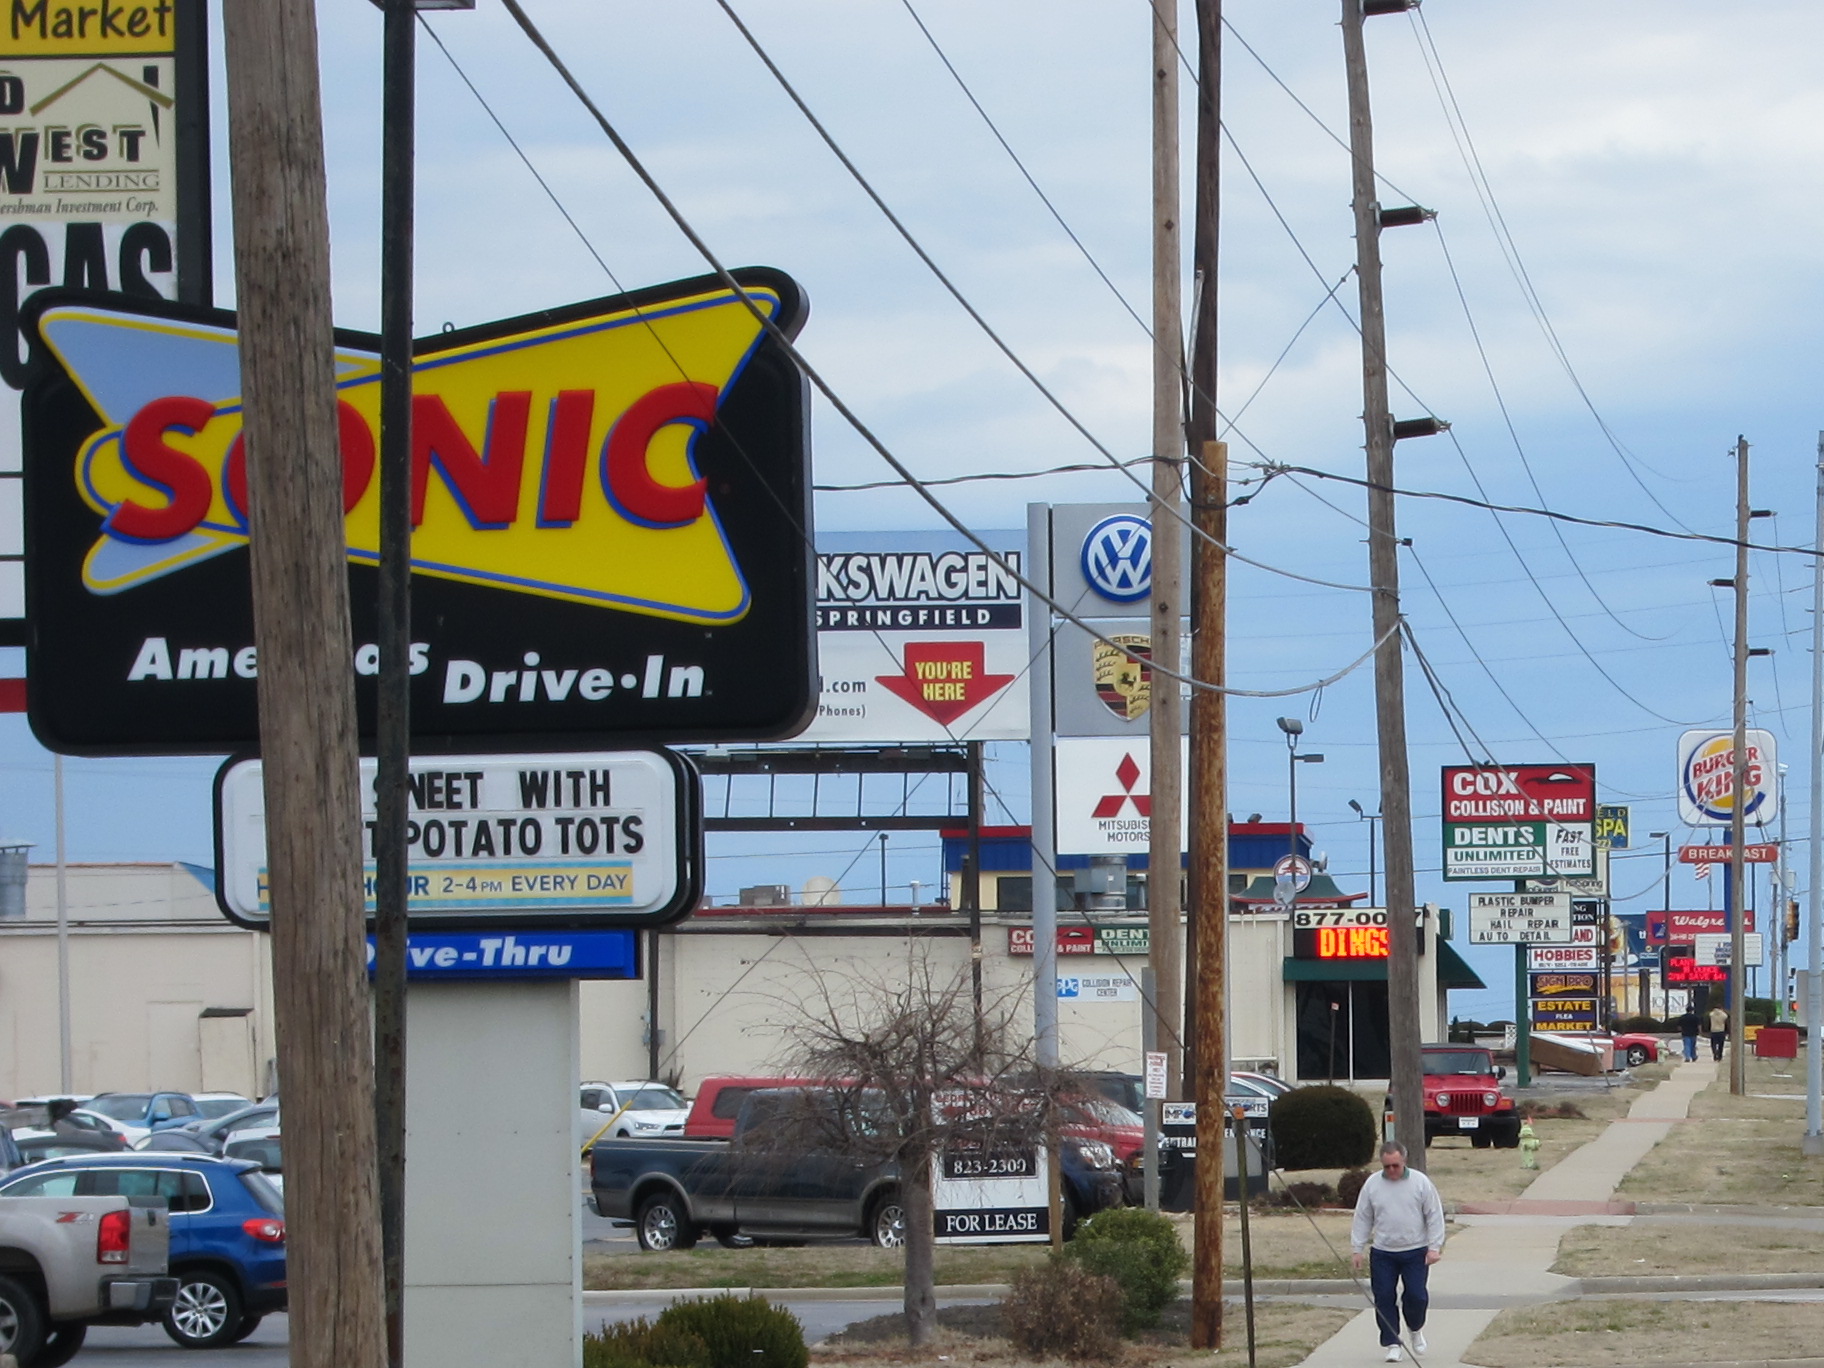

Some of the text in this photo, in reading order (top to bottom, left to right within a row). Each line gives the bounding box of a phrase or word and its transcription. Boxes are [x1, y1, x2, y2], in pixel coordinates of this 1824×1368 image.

[11, 0, 173, 40] Market
[44, 174, 160, 189] LENDING
[55, 199, 121, 214] Investment
[126, 197, 159, 216] Corp.
[817, 552, 1021, 602] KSWAGEN
[816, 609, 991, 626] SPRINGFIELD
[127, 637, 430, 681] Ameas
[915, 661, 972, 680] YOU'RE
[923, 683, 965, 701] HERE
[519, 770, 610, 809] WITH
[1453, 772, 1520, 795] COX
[1450, 799, 1586, 816] COLLISION & PAINT
[1099, 820, 1150, 830] MITSUBIS
[406, 817, 542, 857] POTATO
[555, 815, 644, 855] TOTS
[1107, 831, 1151, 842] MOTORS
[1454, 827, 1535, 845] DENTS
[1555, 830, 1584, 844] FAST
[1454, 850, 1536, 862] UNLIMITED
[1561, 847, 1579, 856] FREE
[1688, 848, 1767, 859] BREAKAST
[1447, 866, 1541, 875] PAINTLESS DENT REPAIR
[1550, 860, 1591, 869] ESTIMATES
[511, 874, 577, 892] EVERY
[586, 873, 627, 890] DAY
[1478, 896, 1555, 906] PLASTIC BUMPER
[1296, 912, 1423, 926] 877-007
[1500, 908, 1534, 917] REPAIR
[1490, 919, 1559, 929] HAIL REPAIR
[1479, 931, 1551, 941] AUTO DETAIL
[1066, 944, 1092, 952] PAINT
[1534, 950, 1593, 961] HOBBIES
[1537, 974, 1594, 988] SIGN PRO
[1537, 1001, 1591, 1010] ESTATE
[1536, 1022, 1593, 1031] MARKET
[946, 1213, 1038, 1232] FOR LEASE
